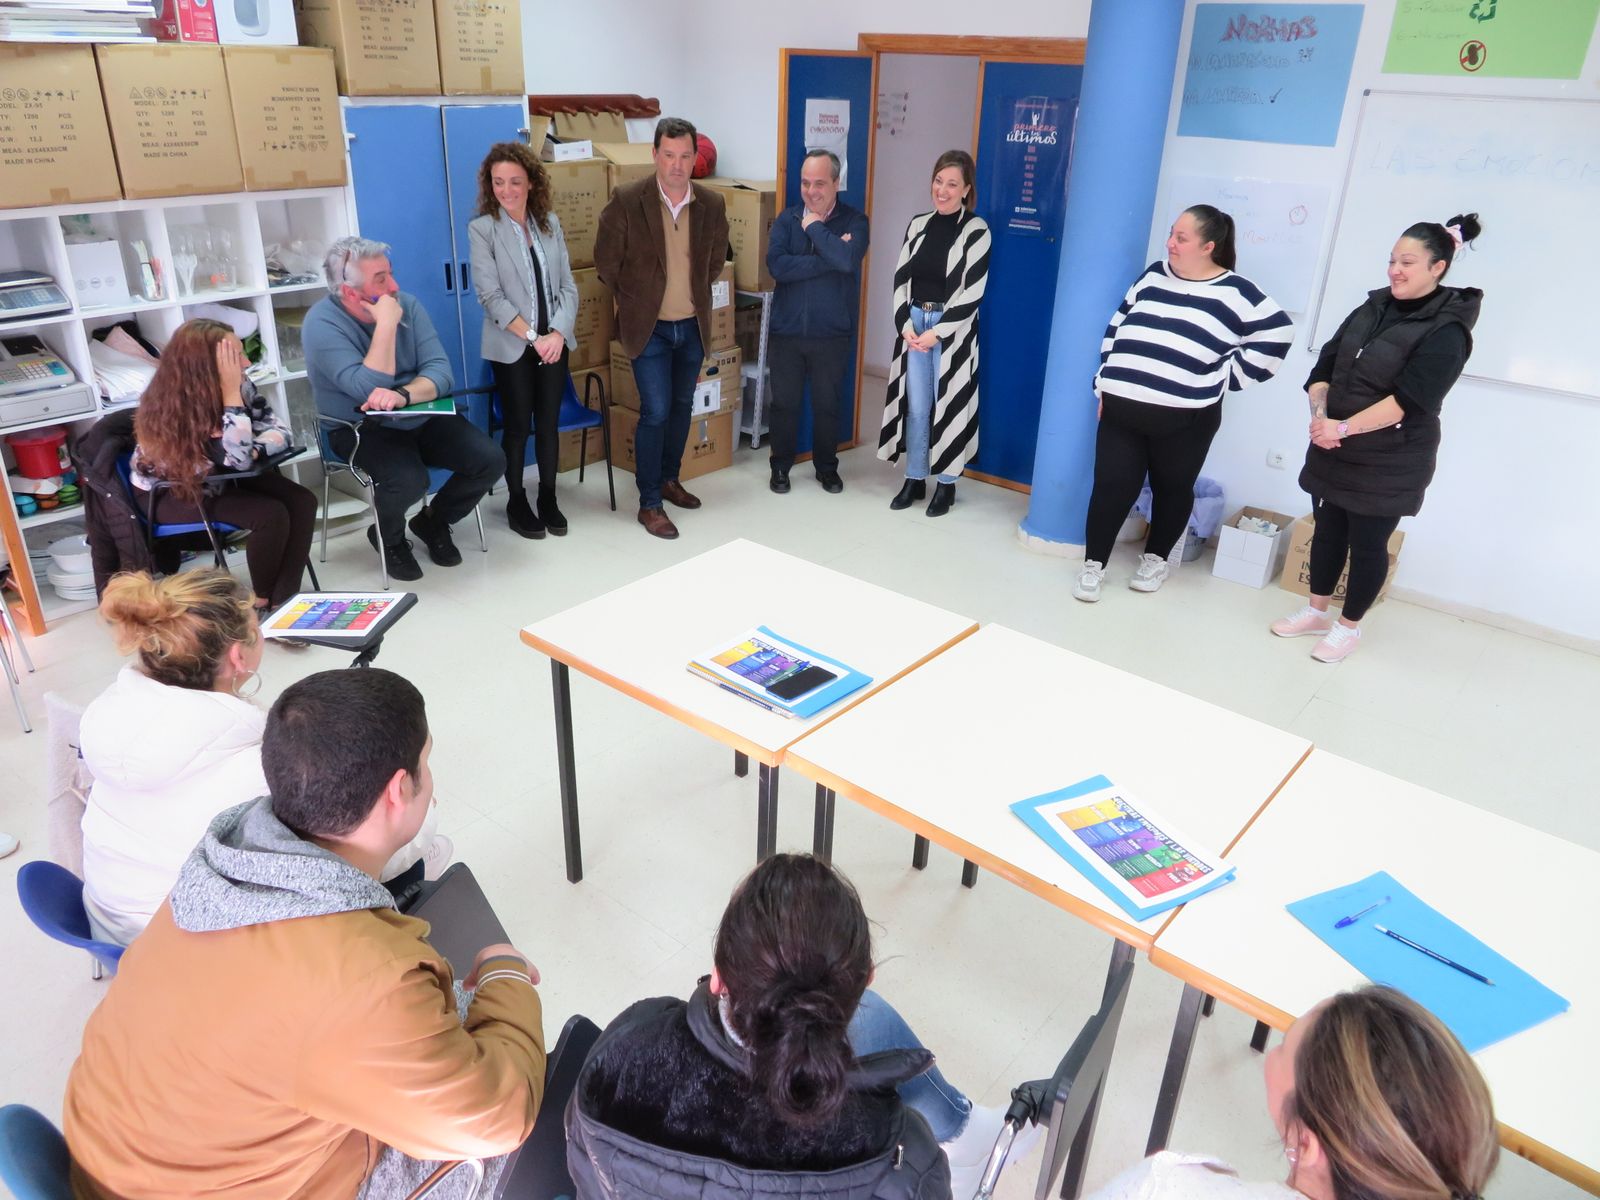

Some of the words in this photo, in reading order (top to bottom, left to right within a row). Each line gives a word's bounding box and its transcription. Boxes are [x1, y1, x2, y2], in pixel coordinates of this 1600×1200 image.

[1217, 13, 1318, 43] NORMAS
[1006, 129, 1058, 145] últimos
[34, 156, 56, 164] CHINA
